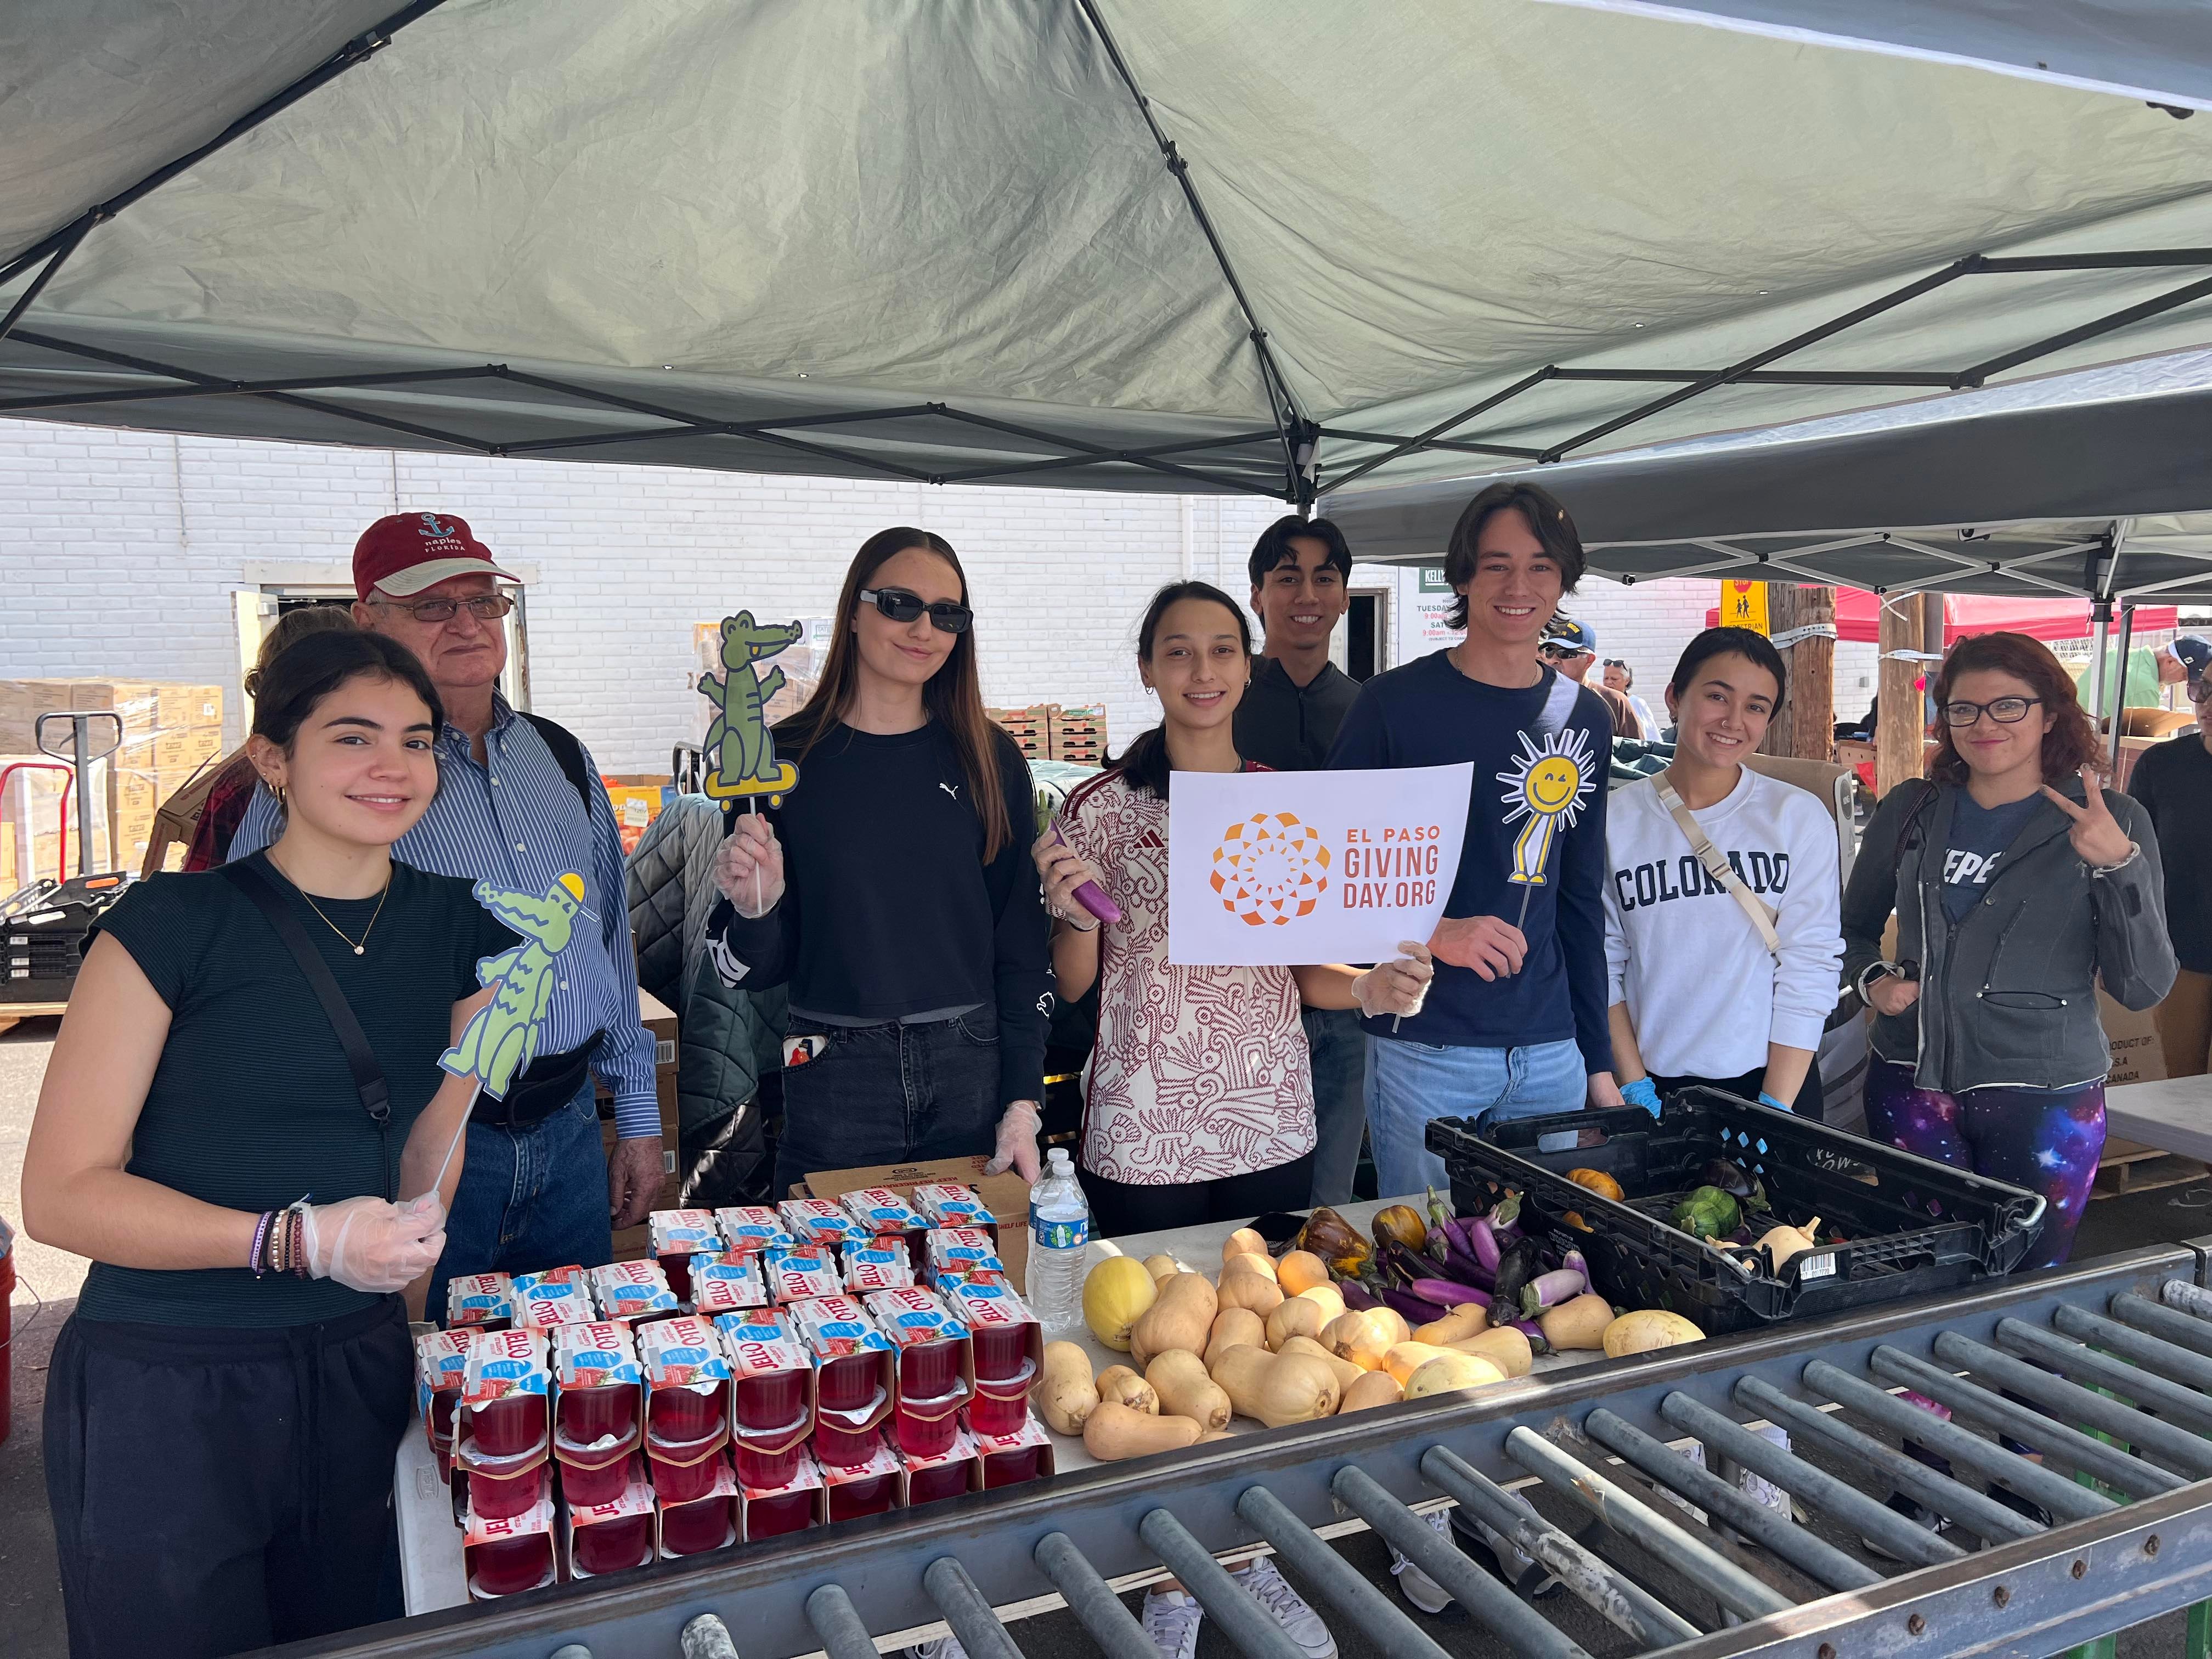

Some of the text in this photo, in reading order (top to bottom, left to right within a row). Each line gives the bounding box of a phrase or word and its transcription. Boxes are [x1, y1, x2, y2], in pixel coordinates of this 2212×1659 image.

[425, 538, 461, 546] naples
[1425, 569, 1445, 582] KELLY
[1347, 825, 1440, 843] EL PASO
[1345, 845, 1438, 878] GIVING
[1944, 848, 2006, 884] EPE
[1344, 879, 1436, 909] DAY.ORG
[871, 1179, 934, 1189] REFRIGERATED
[819, 1298, 858, 1321] JELL-O
[893, 1289, 934, 1311] JELL-O
[501, 1331, 533, 1358] JELL-O
[586, 1323, 621, 1350] JELL-O
[669, 1319, 706, 1345] JELL-O
[740, 1343, 779, 1369] JELL-O
